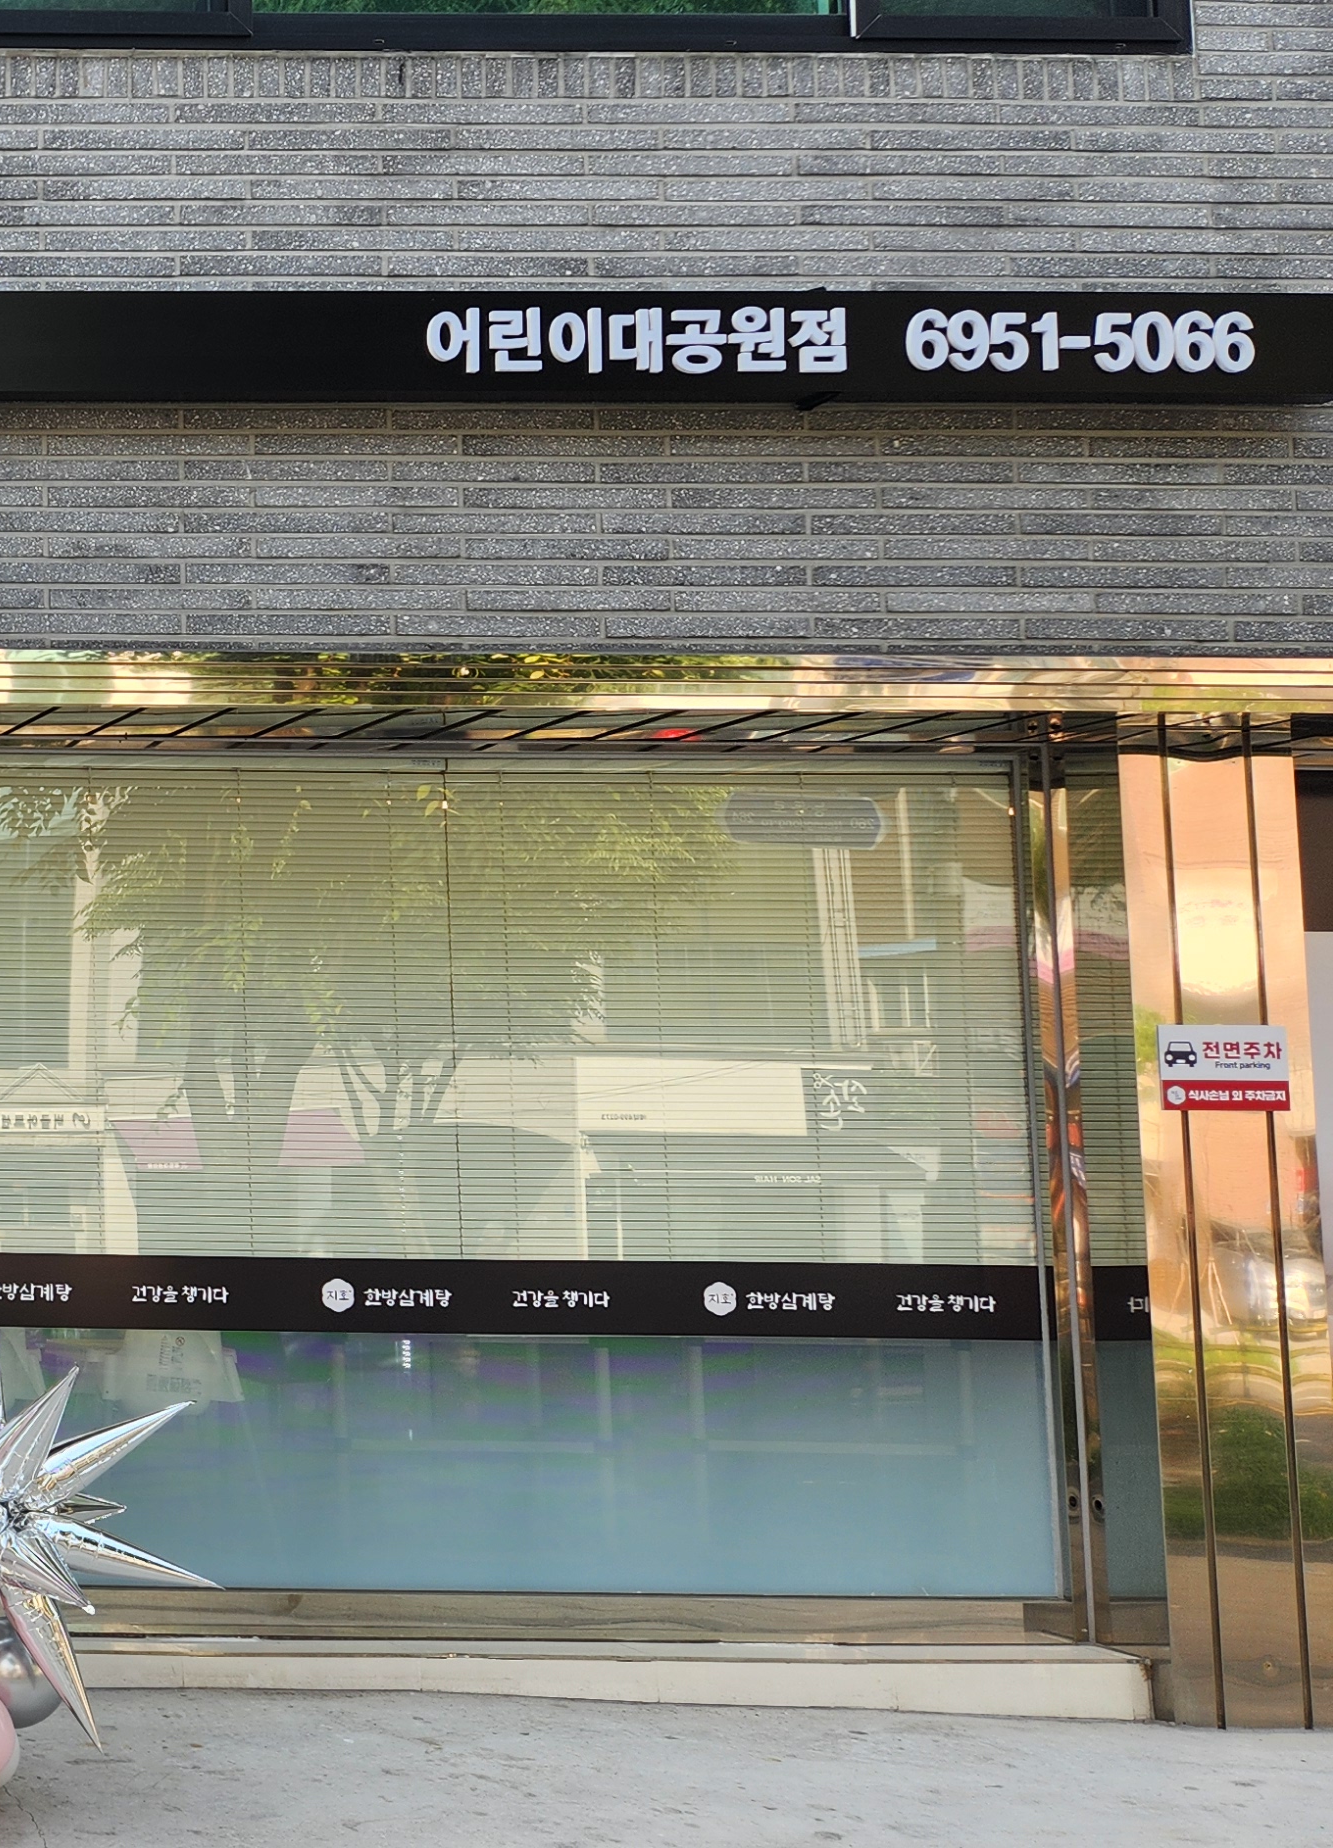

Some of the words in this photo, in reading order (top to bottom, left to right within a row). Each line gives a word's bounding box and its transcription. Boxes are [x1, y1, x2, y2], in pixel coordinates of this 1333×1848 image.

[425, 306, 849, 374] 어린이대공원점
[904, 309, 1257, 373] 6951-5066
[1202, 1041, 1282, 1060] 전면주차
[1215, 1061, 1237, 1069] Front
[1239, 1061, 1271, 1070] parking
[1188, 1090, 1231, 1101] 식사손님
[1232, 1090, 1242, 1101] 외
[1245, 1090, 1286, 1101] 주차금지
[132, 1284, 179, 1304] 건강을
[182, 1284, 229, 1304] 챙기다
[364, 1287, 452, 1308] 한방삼계탕
[512, 1289, 558, 1308] 건강을
[562, 1289, 610, 1308] 챙기다
[745, 1292, 835, 1311] 한방삼계탕
[897, 1293, 943, 1312] 건강을
[946, 1293, 996, 1312] 챙기다
